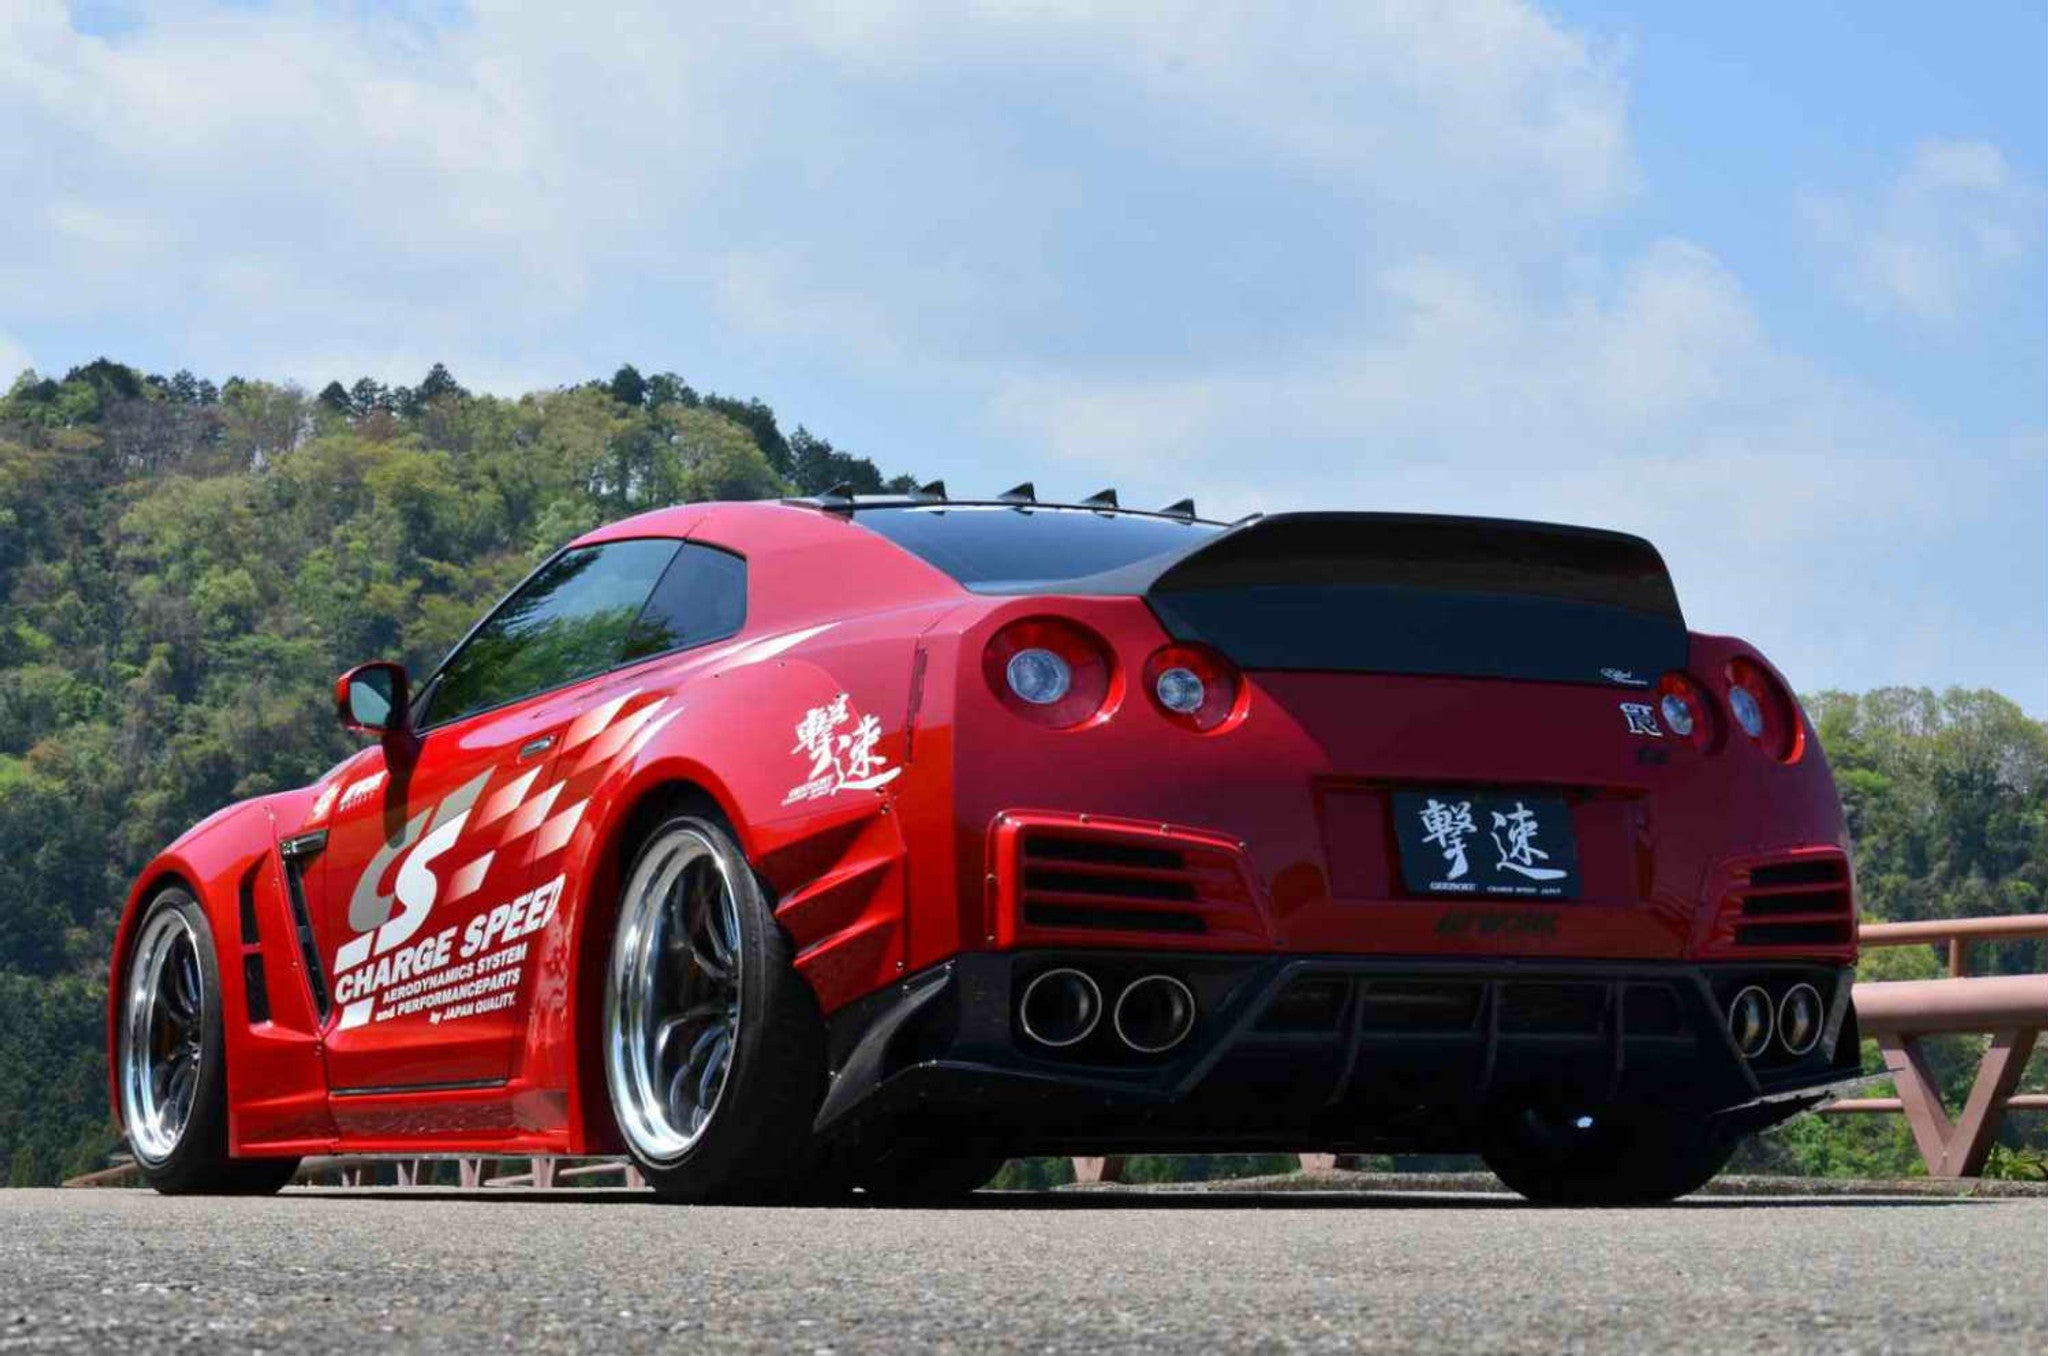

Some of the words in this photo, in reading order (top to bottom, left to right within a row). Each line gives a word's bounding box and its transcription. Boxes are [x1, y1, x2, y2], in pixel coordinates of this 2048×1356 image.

[1419, 799, 1568, 881] 撃速
[335, 926, 459, 1004] CHARGE
[459, 872, 567, 959] SPEED
[382, 962, 475, 1004] AERODYNAMICS
[476, 942, 529, 975] SYSTEM
[443, 1003, 475, 1021] JAPAN
